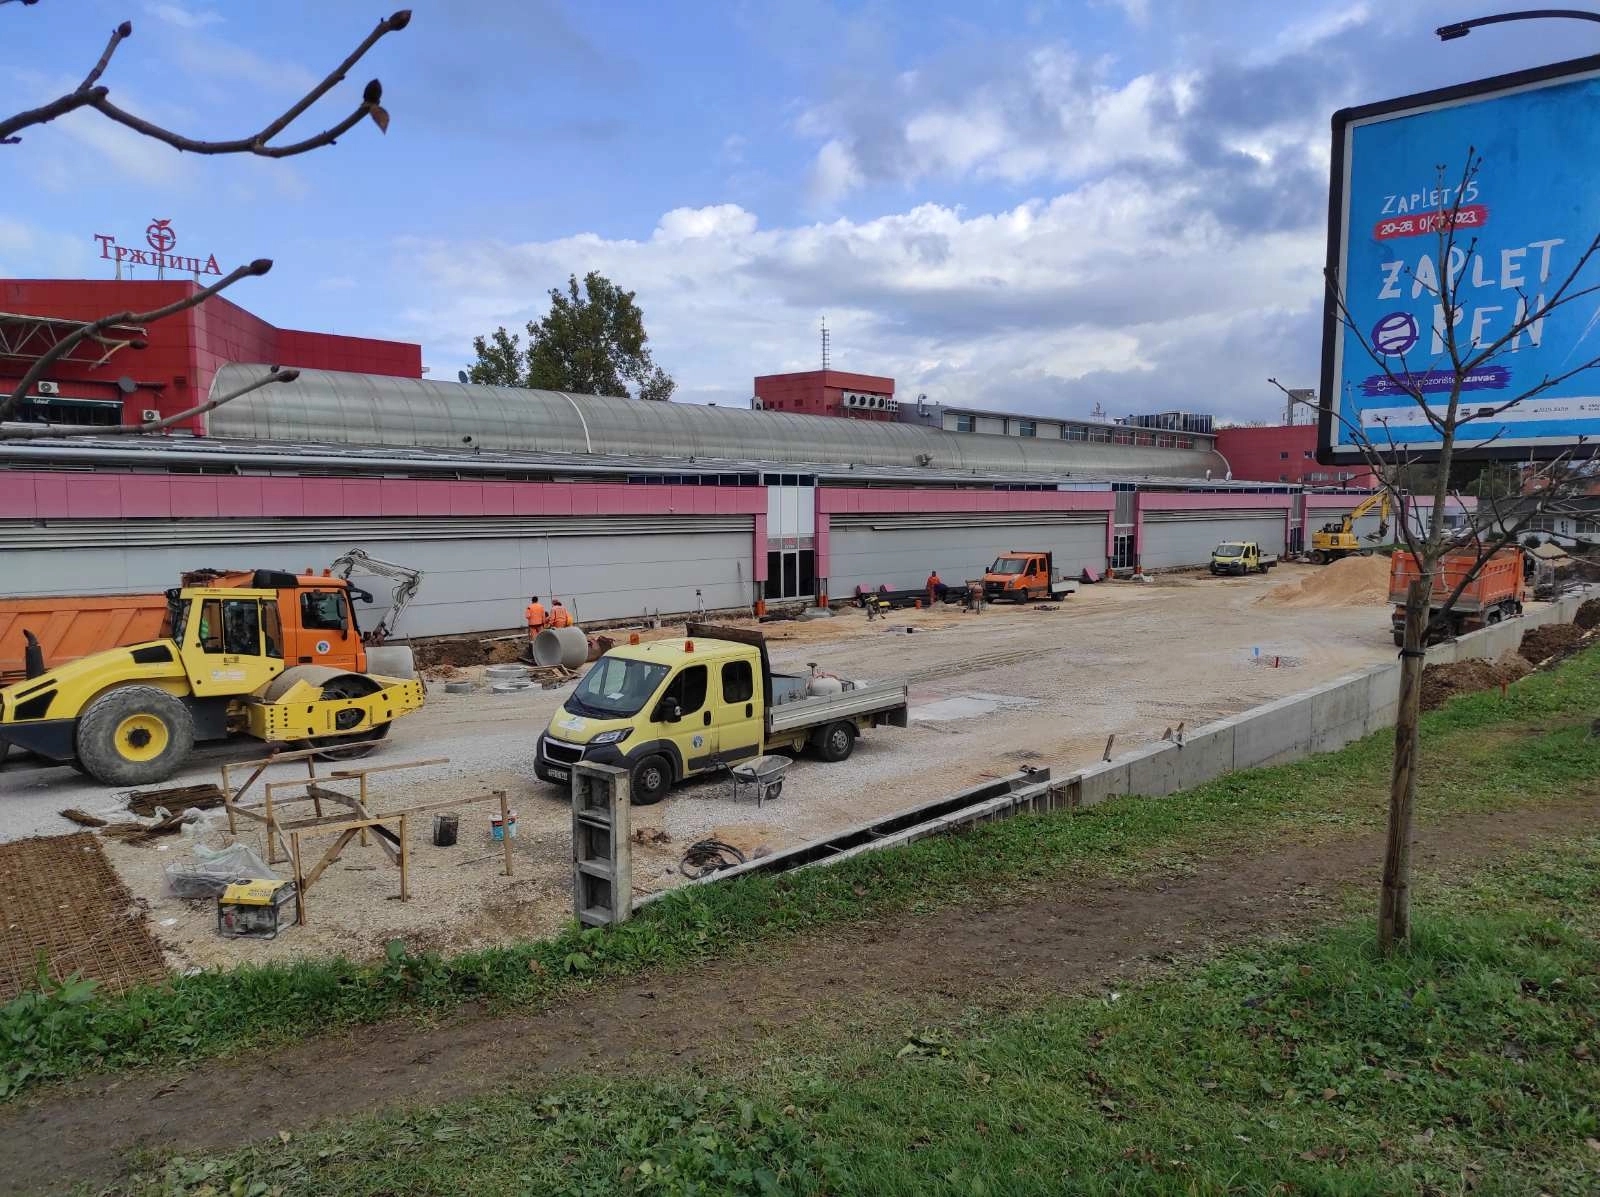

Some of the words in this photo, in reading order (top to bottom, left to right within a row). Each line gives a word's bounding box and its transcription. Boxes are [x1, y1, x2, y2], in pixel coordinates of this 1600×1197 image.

[1381, 187, 1450, 213] ZAPLET
[1454, 180, 1479, 204] 15
[1376, 239, 1565, 299] ZAPLET
